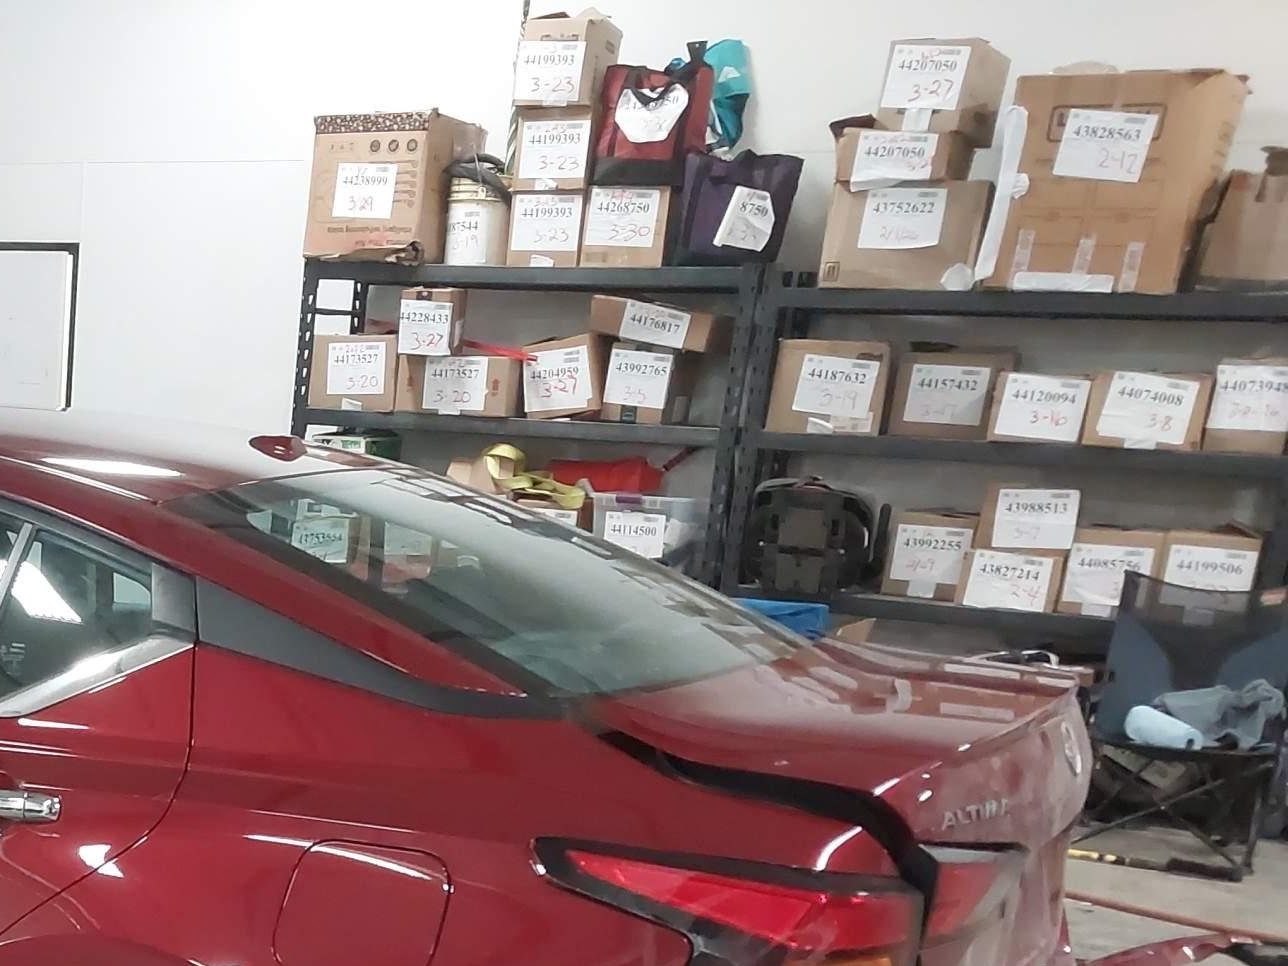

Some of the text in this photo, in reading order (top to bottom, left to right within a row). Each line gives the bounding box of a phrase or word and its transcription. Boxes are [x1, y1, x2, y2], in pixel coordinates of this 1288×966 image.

[524, 54, 575, 66] 44199393
[898, 60, 958, 72] 44207050
[530, 76, 575, 94] 3-23
[908, 78, 954, 102] 3-27
[528, 133, 581, 145] 44199393
[1073, 125, 1142, 140] 43828563
[864, 146, 926, 159] 44207050
[539, 155, 580, 171] 3-23
[343, 175, 388, 186] 44238999
[521, 207, 573, 218] 44199393
[597, 201, 650, 213] 44268750
[873, 202, 935, 214] 43752622
[400, 312, 449, 325] 44228433
[630, 313, 680, 333] 44176817
[334, 353, 379, 364] 44173527
[431, 368, 480, 379] 44173527
[530, 366, 579, 380] 44204959
[616, 361, 668, 377] 43992765
[808, 367, 867, 384] 44187632
[917, 378, 978, 391] 44157432
[1012, 389, 1077, 405] 44120094
[1117, 385, 1184, 407] 44074008
[1005, 502, 1068, 515] 43988513
[610, 524, 657, 537] 44114500
[904, 537, 962, 551] 43992255
[979, 563, 1041, 581] 43827214
[1176, 559, 1243, 575] 44199506
